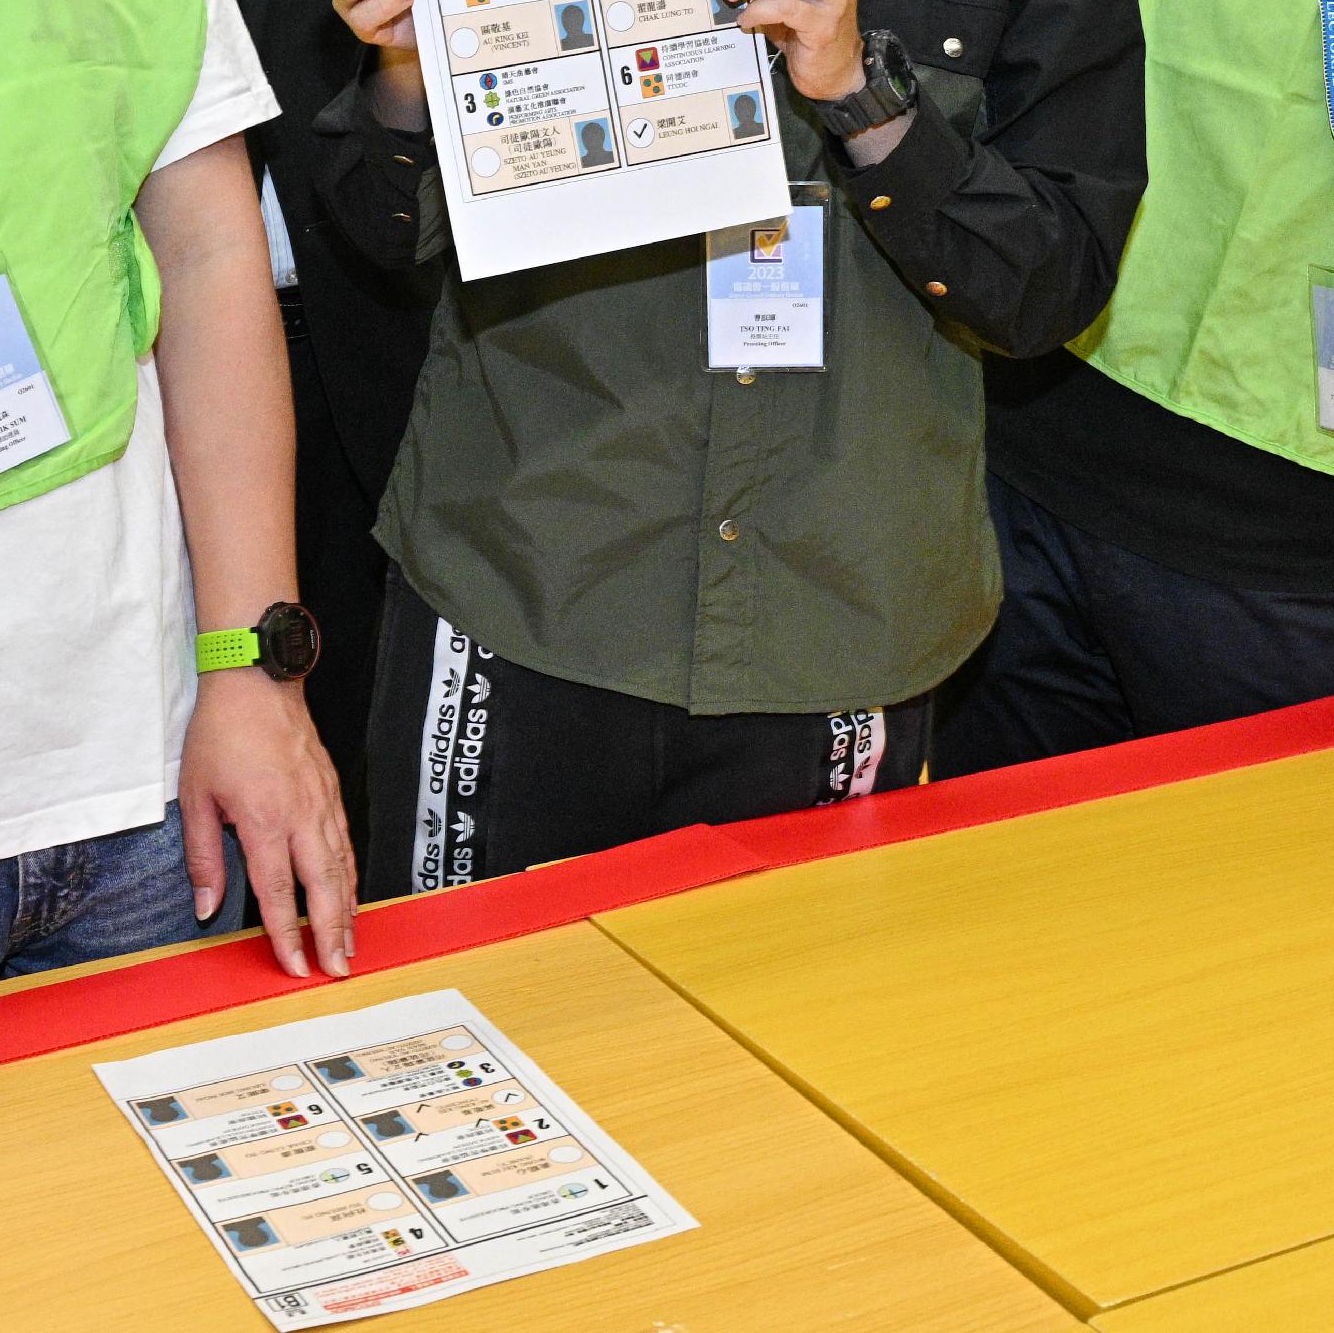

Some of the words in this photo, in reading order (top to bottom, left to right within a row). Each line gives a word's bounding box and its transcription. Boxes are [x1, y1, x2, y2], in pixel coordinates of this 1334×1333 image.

[638, 14, 660, 23] CHAK
[661, 10, 682, 19] LUNG
[683, 7, 694, 15] TO
[483, 37, 492, 46] AU
[495, 34, 514, 43] KING
[491, 40, 530, 52] (VINCENT)
[662, 48, 704, 61] CONTINUOUS
[704, 43, 736, 53] LEARNING
[664, 56, 705, 68] ASSOCIATION
[620, 65, 633, 85] 6
[506, 95, 531, 104] NATURAL
[550, 86, 586, 95] ASSOCIATION
[464, 92, 477, 114] 3
[542, 109, 577, 120] ASSOCIATION
[658, 128, 684, 139] LEUNG
[685, 127, 697, 135] HOI
[699, 122, 718, 131] NGAI
[503, 156, 527, 165] SZETO
[540, 148, 567, 159] YEUNG
[512, 164, 531, 173] MAN
[531, 160, 547, 169] YAN
[514, 169, 538, 180] (SZETO
[539, 167, 548, 175] AU
[550, 162, 577, 173] YEUNG)
[748, 266, 785, 280] 2023
[740, 325, 755, 333] TSO
[756, 325, 775, 333] TING
[10, 416, 27, 430] SUM
[427, 704, 455, 795] adidas
[453, 708, 487, 797] adidas
[478, 1062, 495, 1073] 3
[307, 1104, 323, 1115] 6
[532, 1118, 550, 1130] 2
[355, 1162, 374, 1175] 5
[593, 1178, 609, 1190] 1
[408, 1227, 424, 1240] 4
[274, 1294, 300, 1309] B1
